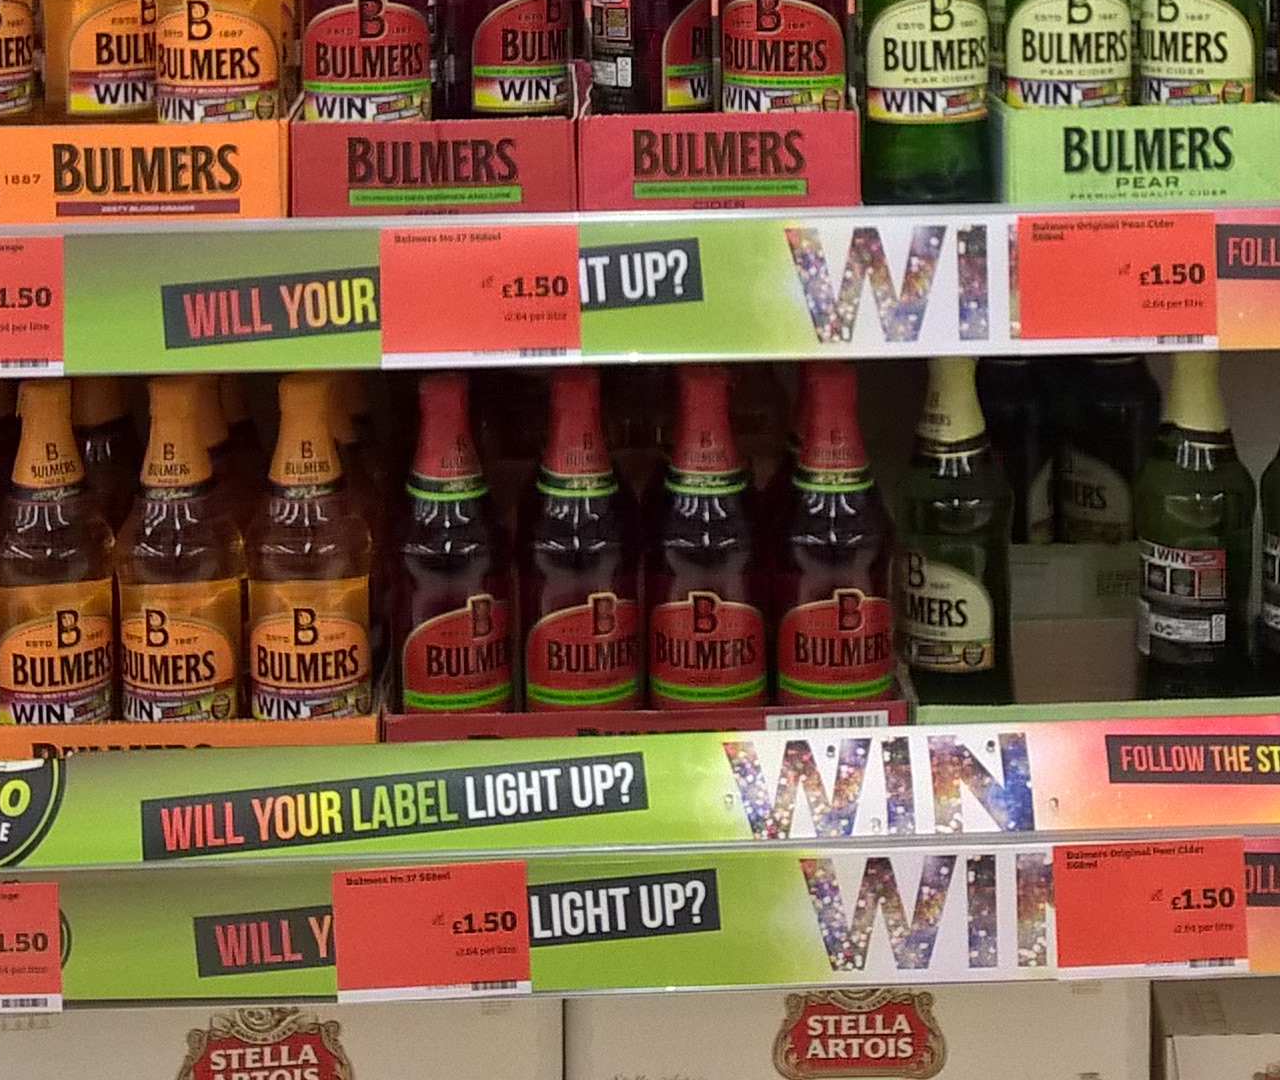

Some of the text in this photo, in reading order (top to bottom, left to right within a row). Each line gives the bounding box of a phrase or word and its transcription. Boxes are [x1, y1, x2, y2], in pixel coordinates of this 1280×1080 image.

[316, 42, 422, 79] BULMERS
[1021, 28, 1128, 65] BULMERS
[882, 90, 937, 113] WIN
[347, 137, 519, 186] BULMERS
[1063, 125, 1234, 174] BULMERS
[4, 174, 41, 185] 1887
[52, 143, 241, 195] BULMERS
[1116, 176, 1180, 189] PEAR
[183, 250, 689, 340] WILL YOUR UP?
[257, 645, 358, 683] BULMERS
[1120, 746, 1204, 773] FOLLOW
[1210, 746, 1253, 773] THE
[724, 732, 1036, 840] WIN
[161, 761, 635, 852] WILL YOUR LABEL LIGHT UP?
[1170, 887, 1236, 910] £1.50
[806, 1014, 913, 1037] STELLA
[806, 1038, 914, 1060] ARTOIS
